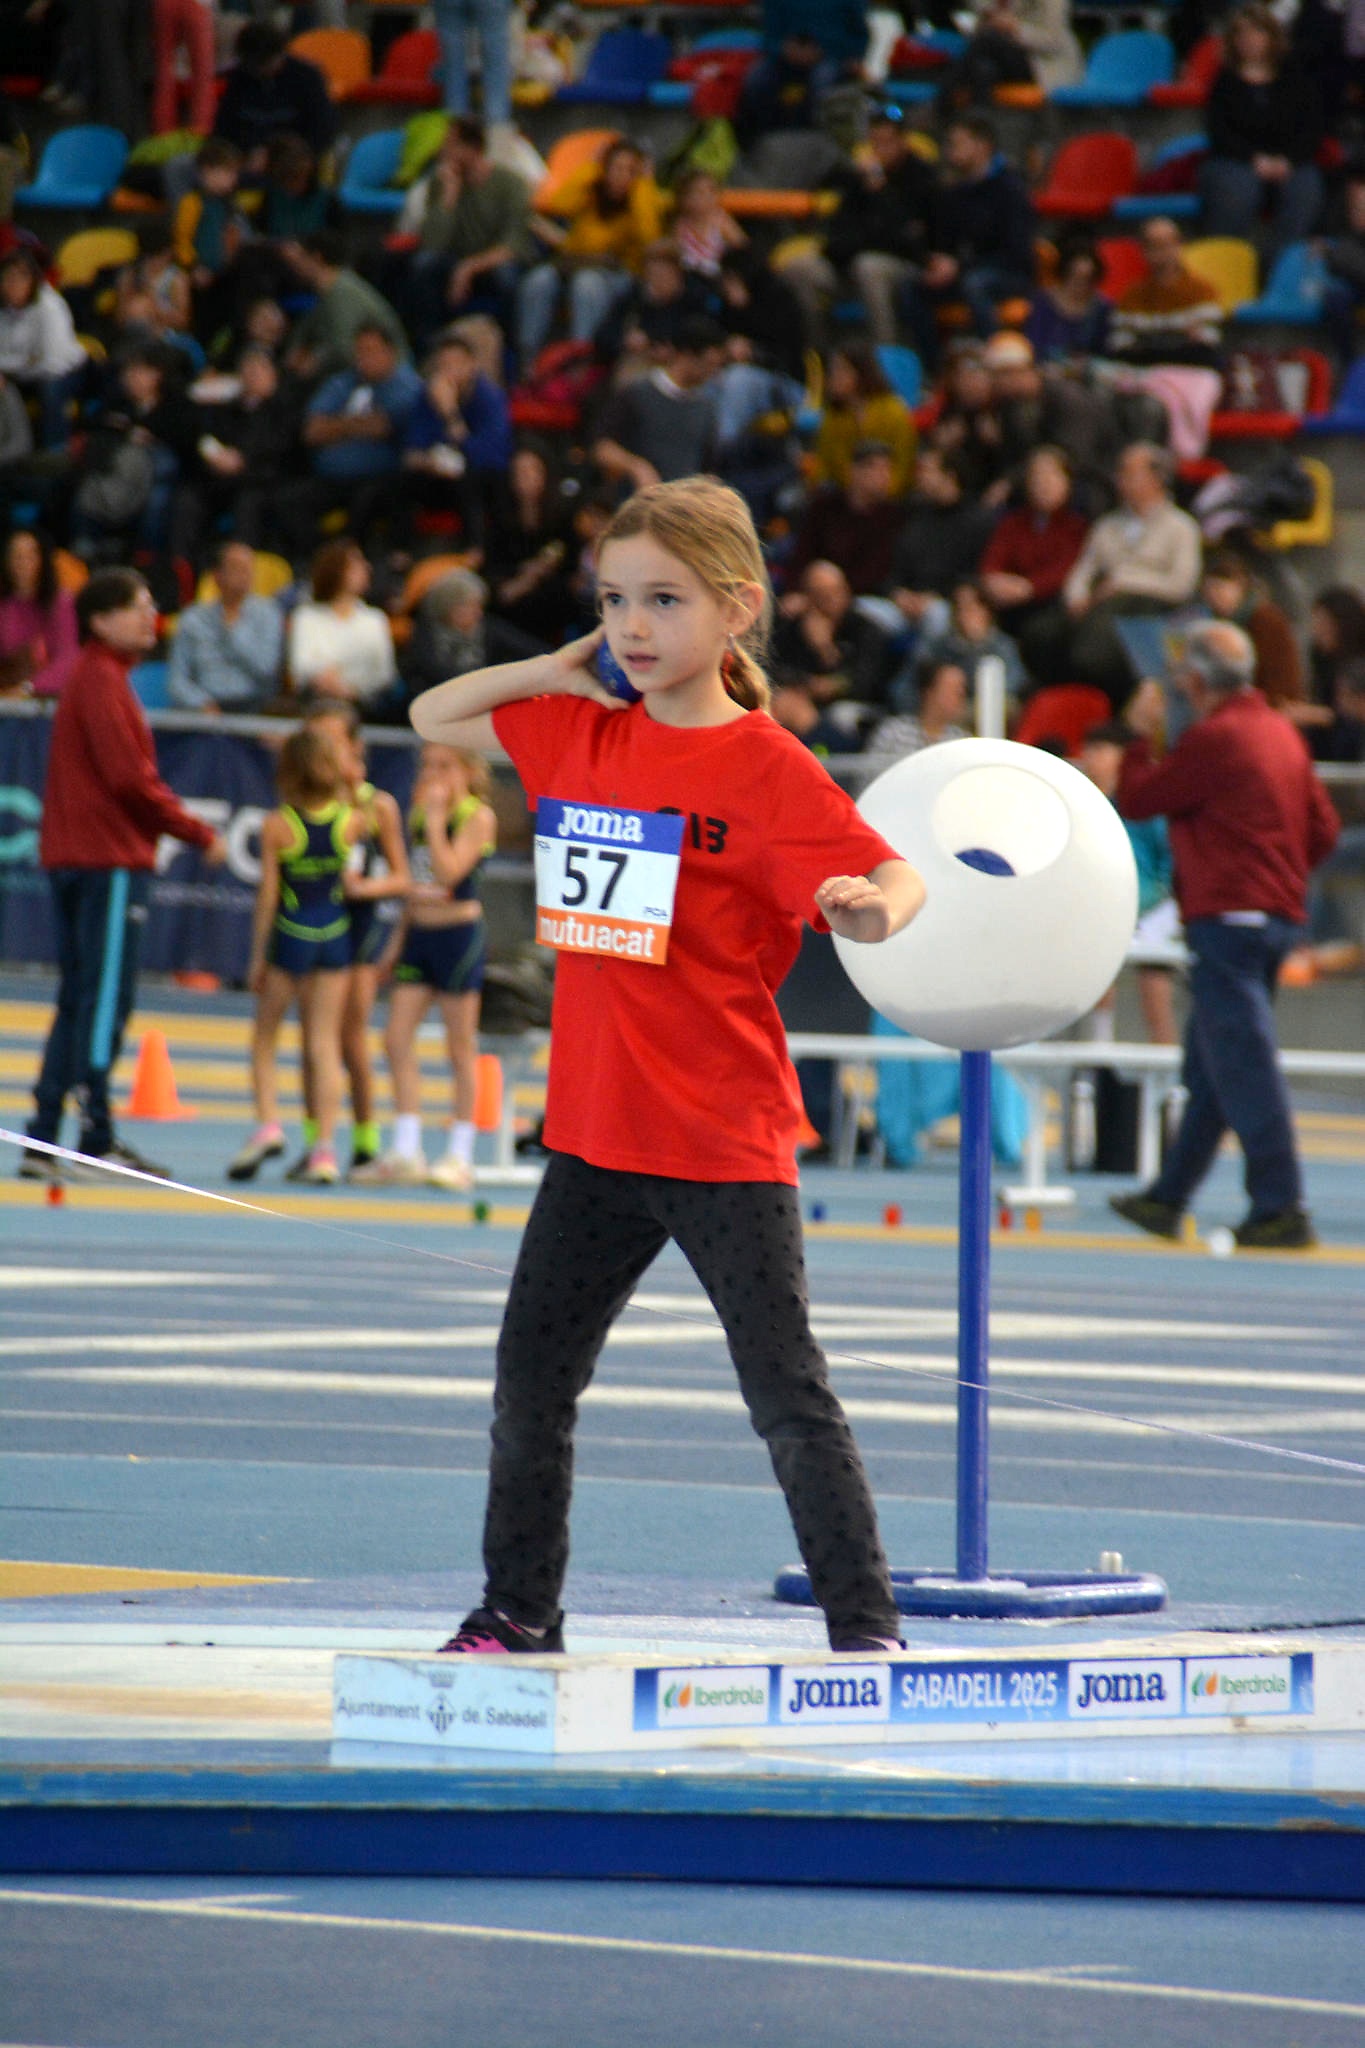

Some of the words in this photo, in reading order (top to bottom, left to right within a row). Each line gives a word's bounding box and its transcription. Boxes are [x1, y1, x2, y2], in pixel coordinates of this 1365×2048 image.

[654, 806, 728, 854] 13
[562, 846, 629, 911] 57
[540, 916, 655, 957] mutuacat
[902, 1673, 1006, 1708] SABADELL
[1009, 1672, 1058, 1707] 2025
[336, 1697, 420, 1720] Ajuntament
[462, 1706, 480, 1724] de
[486, 1706, 548, 1728] Sabadell
